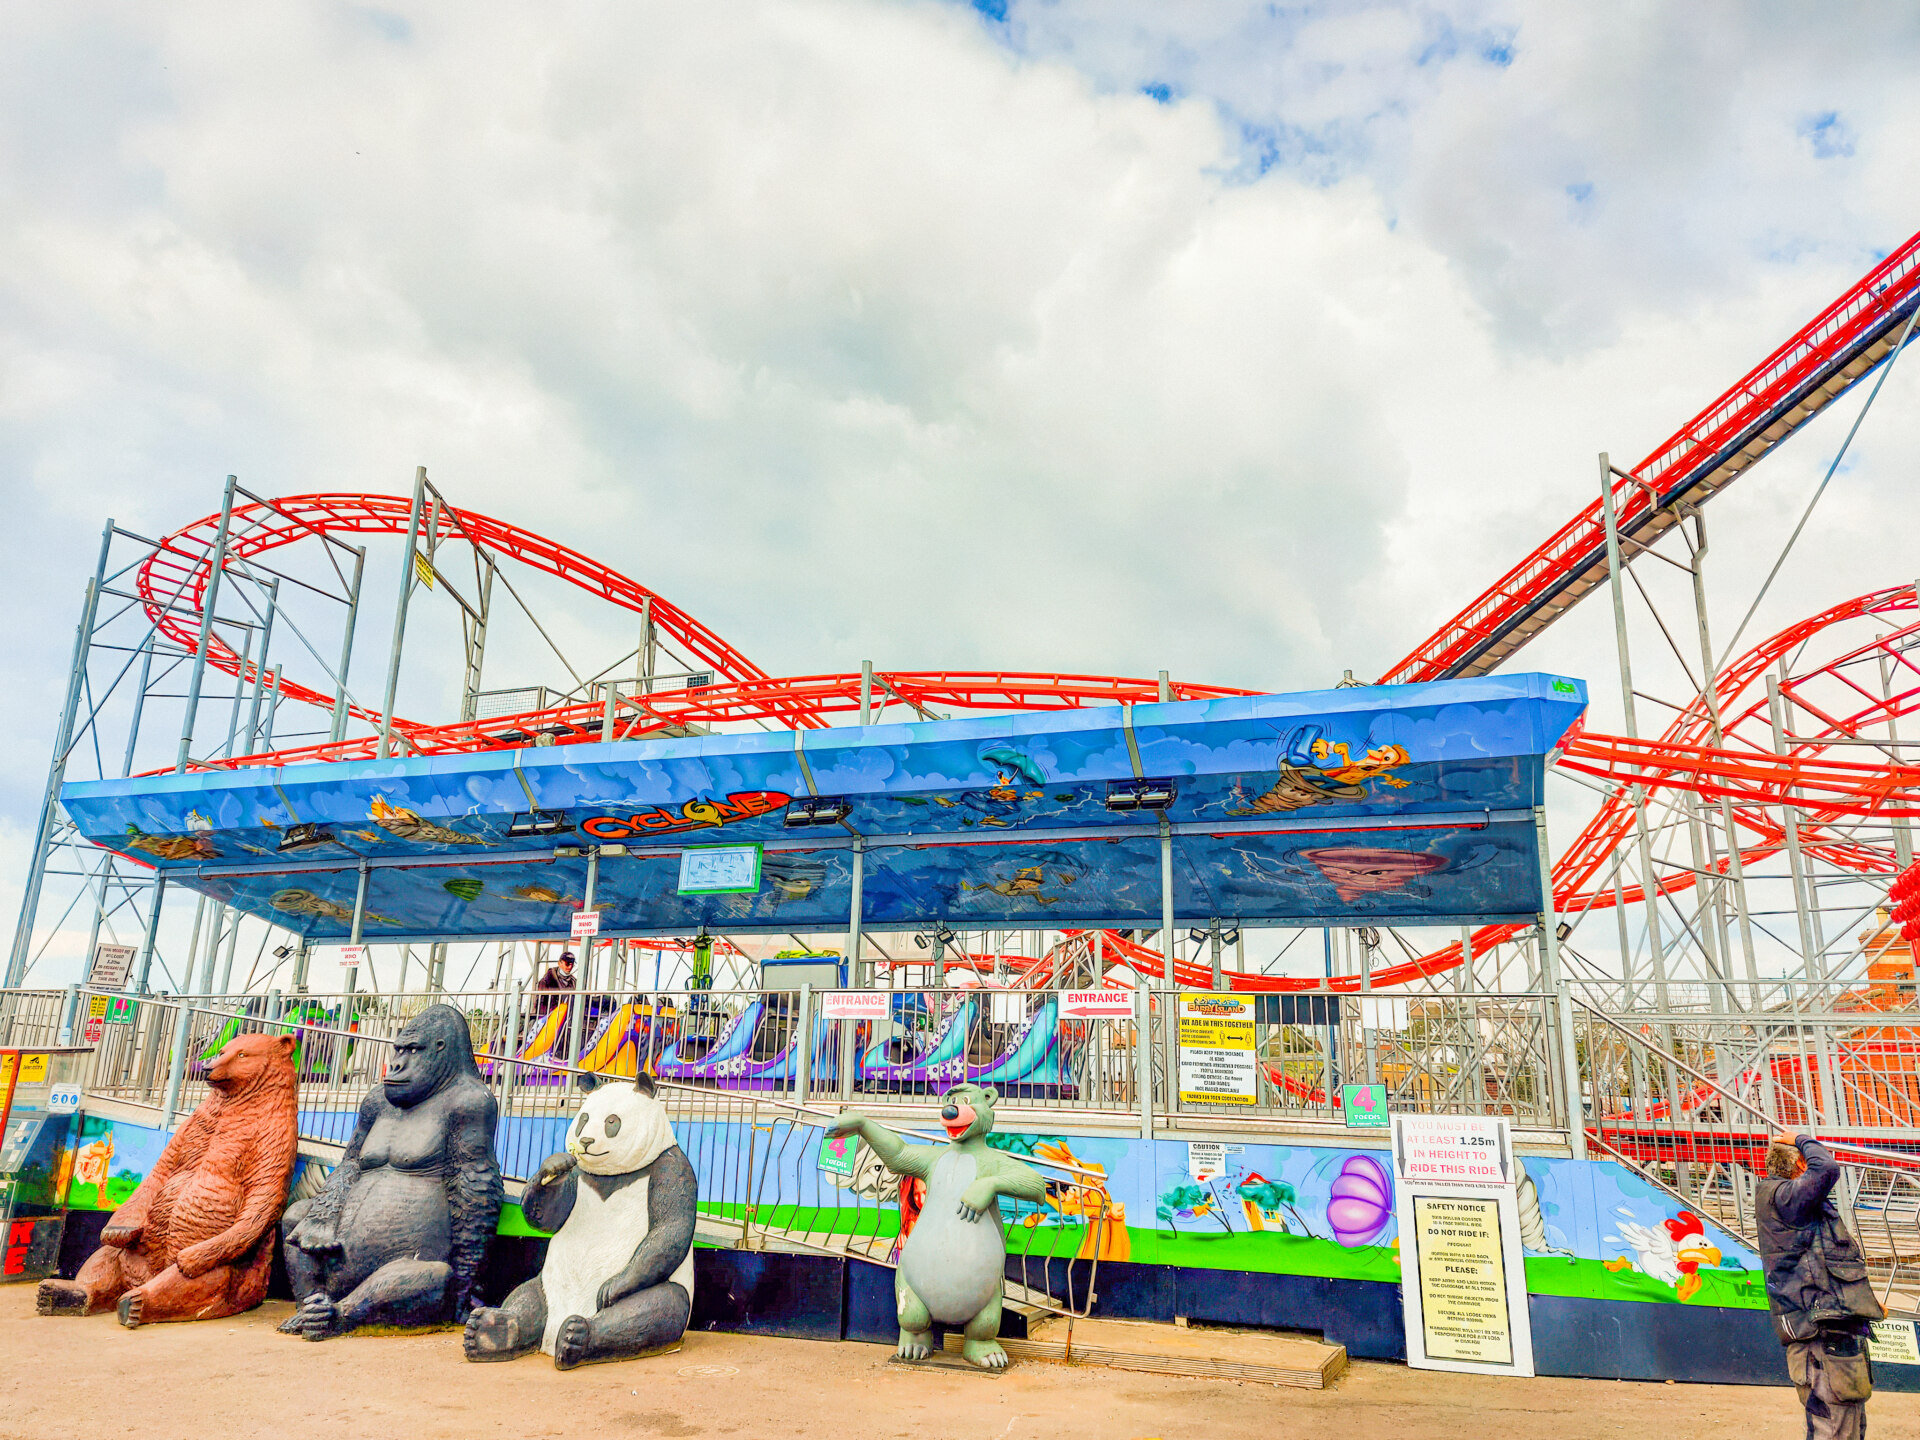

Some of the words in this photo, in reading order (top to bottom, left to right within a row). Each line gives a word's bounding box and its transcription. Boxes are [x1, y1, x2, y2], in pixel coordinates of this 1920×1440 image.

[582, 793, 774, 839] CYCLONE
[826, 994, 885, 1005] ENTRANCE
[1068, 993, 1129, 1003] ENTRANCE
[1353, 1086, 1376, 1112] 4
[1411, 1121, 1433, 1130] YOU
[1436, 1122, 1468, 1131] MUST
[1471, 1123, 1485, 1131] BE
[1407, 1136, 1418, 1144] AT
[1422, 1136, 1456, 1145] LEAST
[1460, 1136, 1495, 1146] 1.25m
[828, 1138, 848, 1158] 4
[1414, 1150, 1425, 1158] IN
[1429, 1150, 1470, 1159] HEIGHT
[1473, 1152, 1487, 1160] TO
[1410, 1164, 1437, 1172] RIDE
[1440, 1164, 1465, 1174] THIS
[1469, 1166, 1496, 1175] RIDE
[1445, 1266, 1478, 1274] PLEASE:
[1870, 1322, 1910, 1331] AUTION
